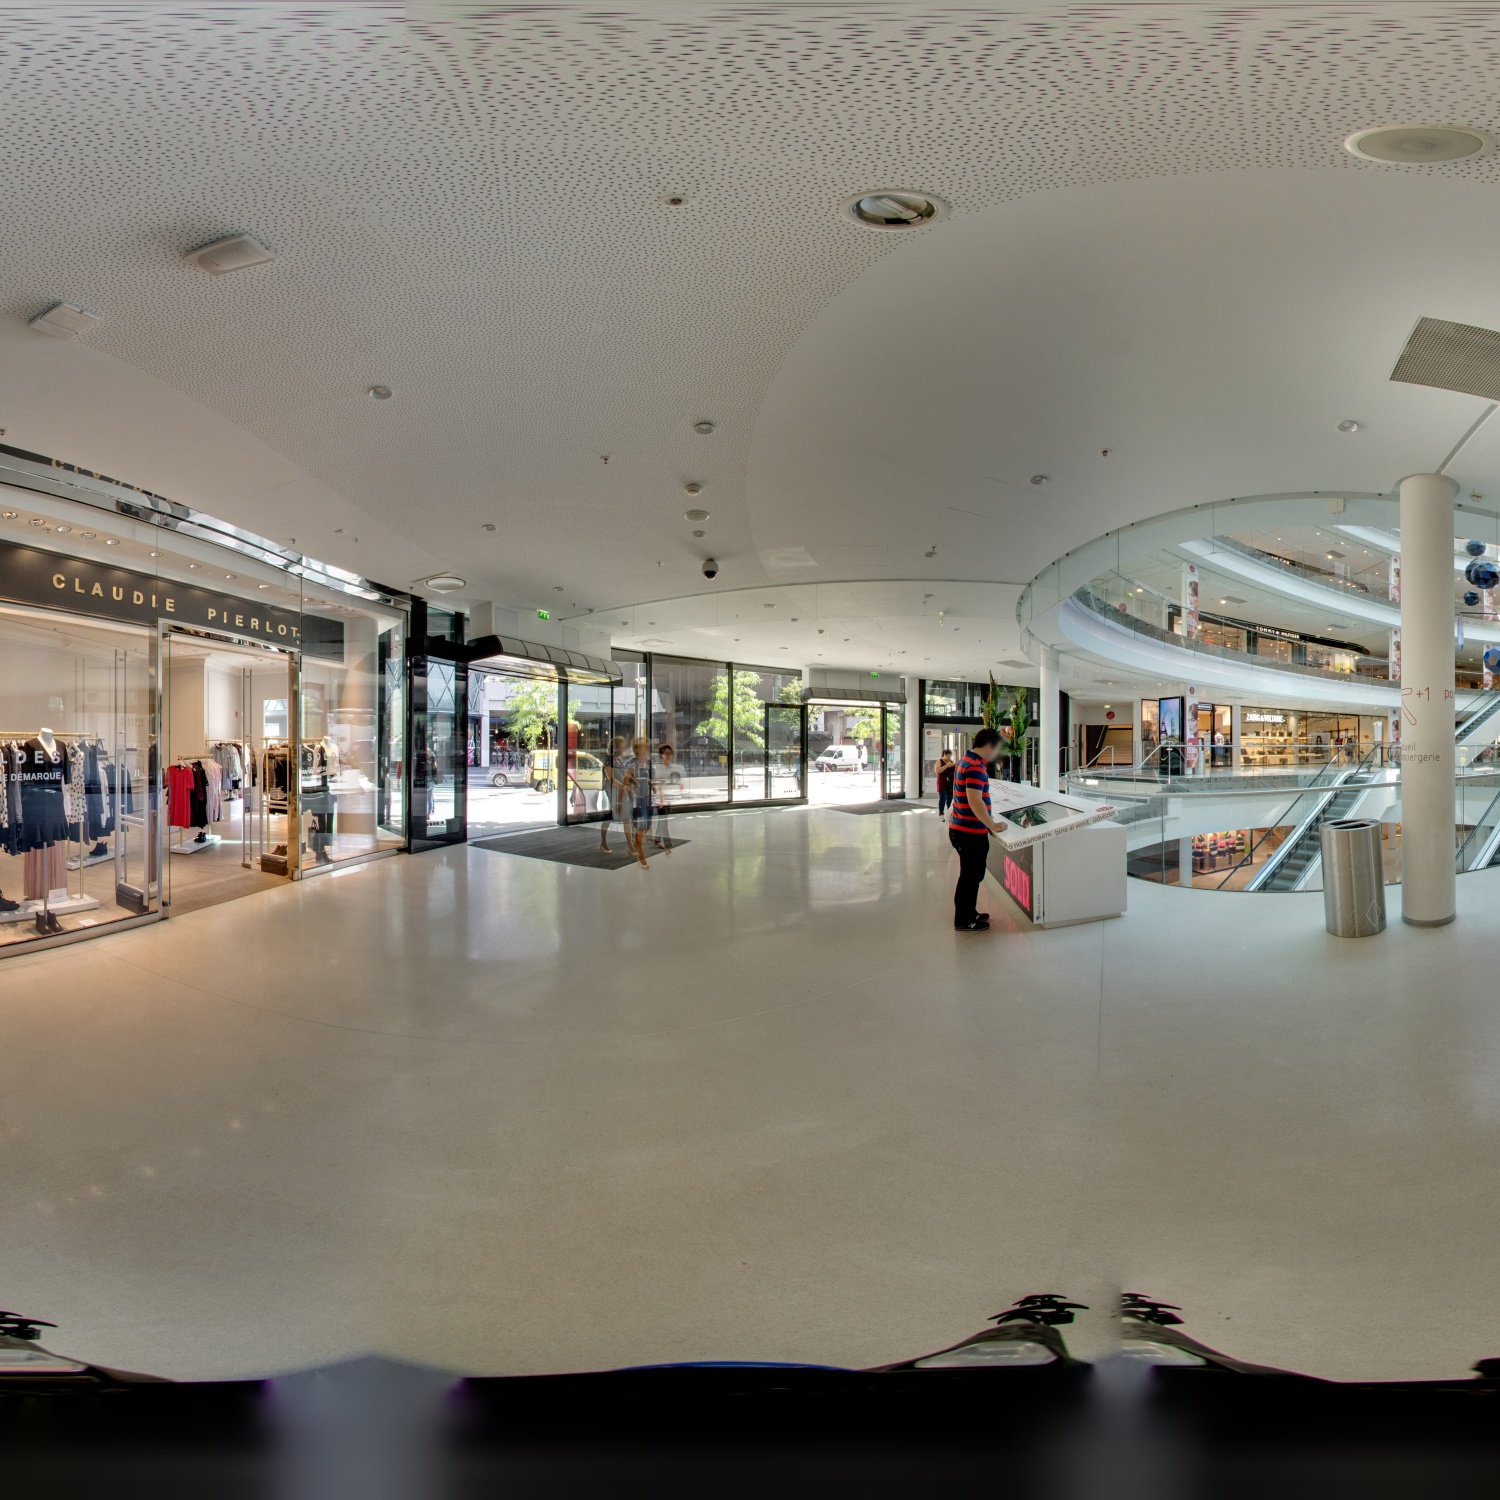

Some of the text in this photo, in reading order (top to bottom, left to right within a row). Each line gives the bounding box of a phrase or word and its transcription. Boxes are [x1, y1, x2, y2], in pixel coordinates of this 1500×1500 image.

[52, 573, 299, 638] CLAUDIE PIERLOT
[1256, 626, 1275, 634] TOMMY
[11, 771, 61, 782] DÉMARQUE
